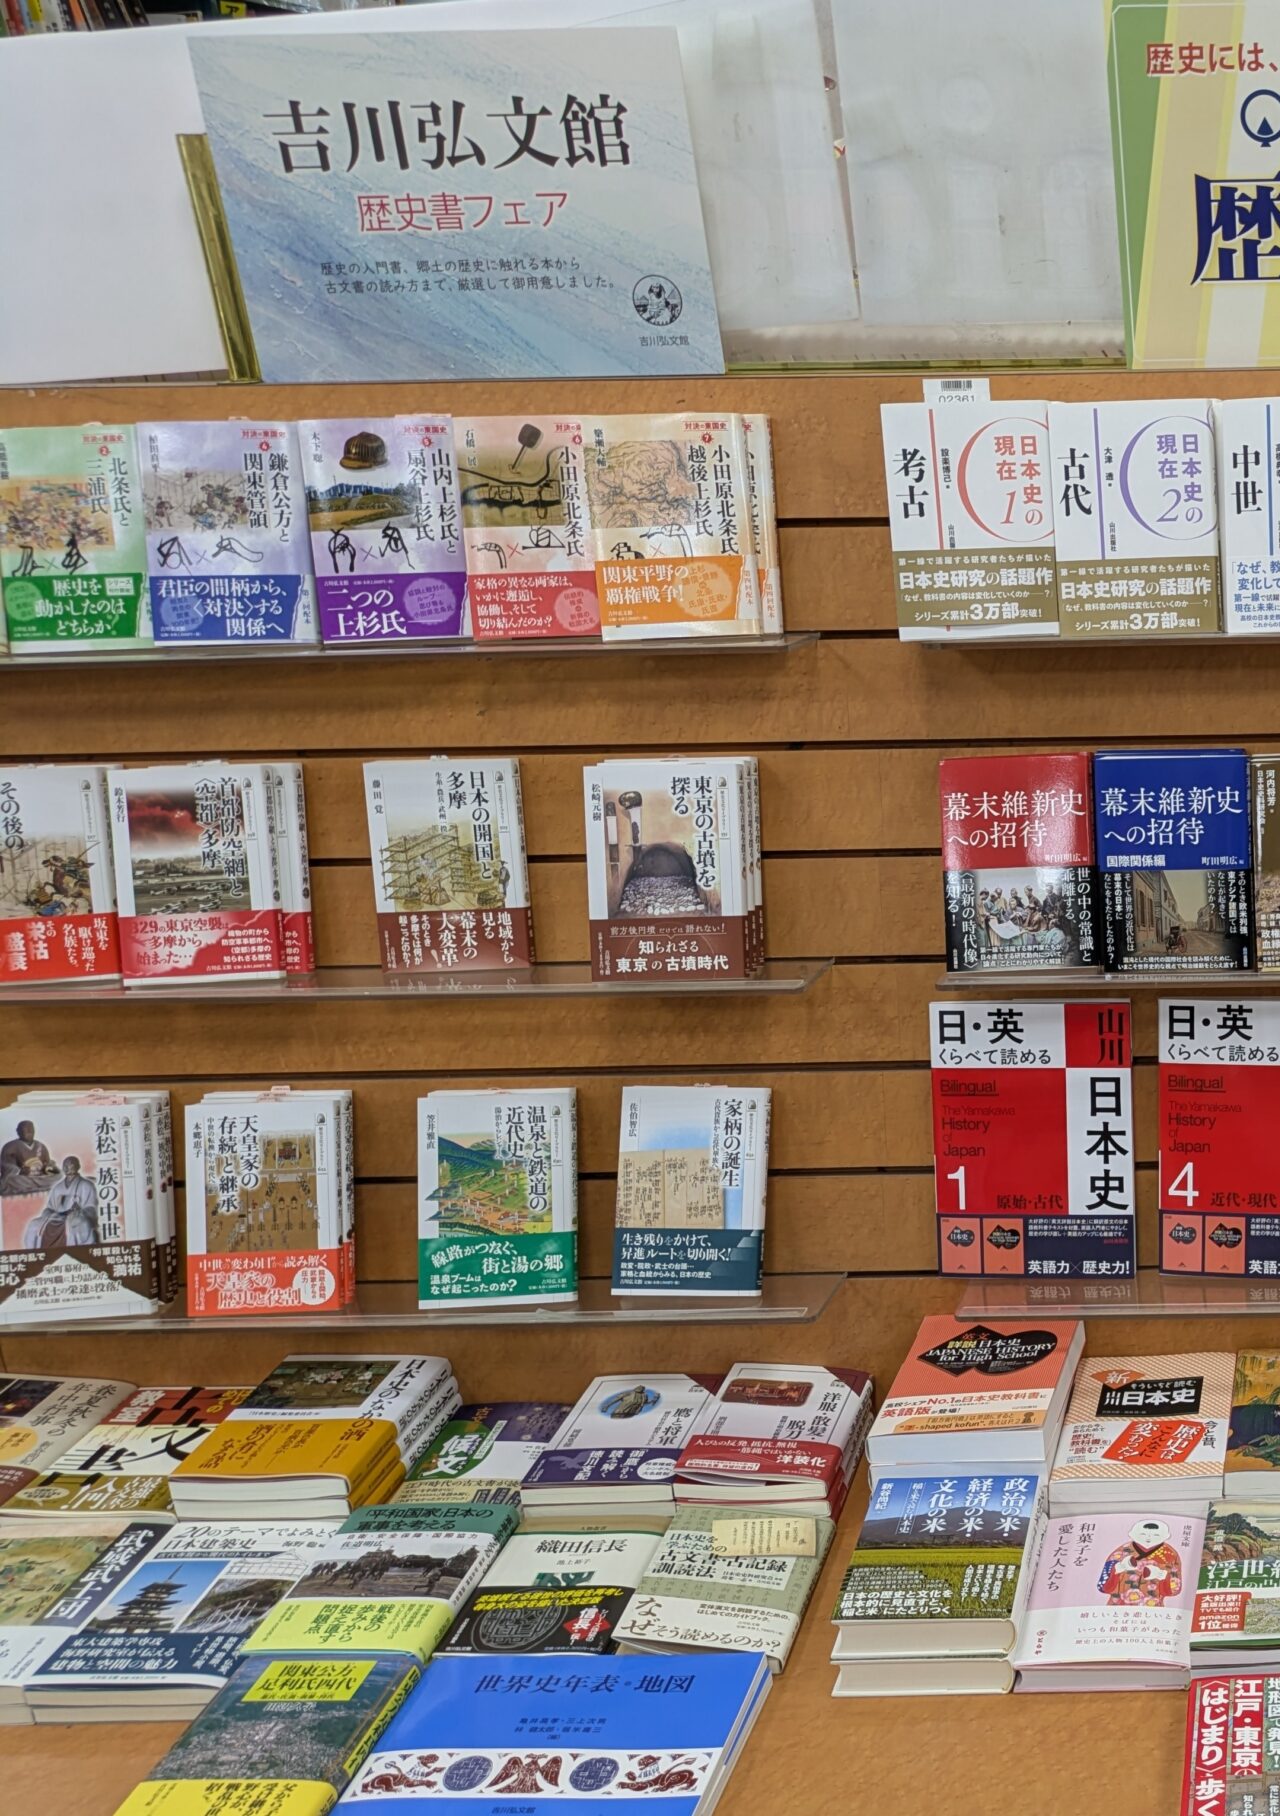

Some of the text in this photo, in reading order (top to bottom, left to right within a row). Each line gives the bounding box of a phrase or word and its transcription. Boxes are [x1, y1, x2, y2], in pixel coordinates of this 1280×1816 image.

[263, 93, 631, 173] 吉川弘文館
[358, 191, 567, 233] 歴史書フェア
[321, 256, 580, 276] 歴史の入門書、郷土の歴史に触れる本から
[325, 276, 616, 294] 古文書の読み方まで、厳選して御用意しました。
[639, 334, 690, 347] 吉川弘文館
[994, 435, 1017, 480] 現在
[1156, 434, 1179, 479] 現在
[87, 459, 108, 514] 三浦氏
[108, 457, 129, 527] 北条氏と
[244, 453, 269, 529] 関東管領
[268, 452, 291, 542] 鎌倉公方と
[894, 448, 929, 519] 考古
[1020, 435, 1044, 526] 日本史の
[1058, 448, 1093, 518] 古代
[1182, 433, 1204, 524] 日本史の
[1231, 445, 1263, 515] 中世
[1157, 488, 1182, 524] 2
[898, 568, 1053, 589] 日本史研究の話題作
[1061, 578, 1211, 600] 日本史研究の話題作
[226, 618, 284, 637] 関係へ
[448, 772, 466, 809] 多摩
[671, 777, 688, 816] 探る
[943, 790, 1085, 820] 幕末維新史
[1100, 786, 1243, 814] 幕末維新史
[693, 776, 716, 888] 東京の古墳を
[947, 822, 1047, 847] への招待
[1104, 818, 1205, 846] への招待
[1106, 855, 1166, 868] 国際関係編
[638, 940, 699, 954] 知られざる
[938, 1008, 1024, 1044] 日・英
[1097, 1009, 1124, 1065] 山川
[1168, 1004, 1253, 1041] 日・英
[938, 1048, 1052, 1065] くらべて読める
[1167, 1044, 1280, 1062] くらべて読める
[940, 1078, 996, 1095] Bilingual
[1168, 1074, 1224, 1091] Bilingual
[505, 1106, 524, 1158] 近代史
[941, 1118, 990, 1134] History
[1168, 1113, 1216, 1130] History
[239, 1115, 259, 1189] 天皇家の
[526, 1105, 548, 1212] 温泉と鉄道の
[722, 1098, 743, 1188] 家柄の誕生
[943, 1143, 986, 1158] Japan
[1085, 1076, 1129, 1211] 日本史
[1169, 1140, 1211, 1154] Japan
[94, 1117, 120, 1240] 赤松一族の中世
[947, 1166, 966, 1210] 1
[1168, 1162, 1199, 1207] 4
[996, 1343, 1056, 1355] HISTORY
[997, 1351, 1038, 1359] School
[919, 1480, 958, 1533] 文化の米
[162, 1538, 261, 1549] 日本建築史
[536, 1539, 628, 1554] 織田信長
[1073, 1522, 1096, 1566] 和菓子を
